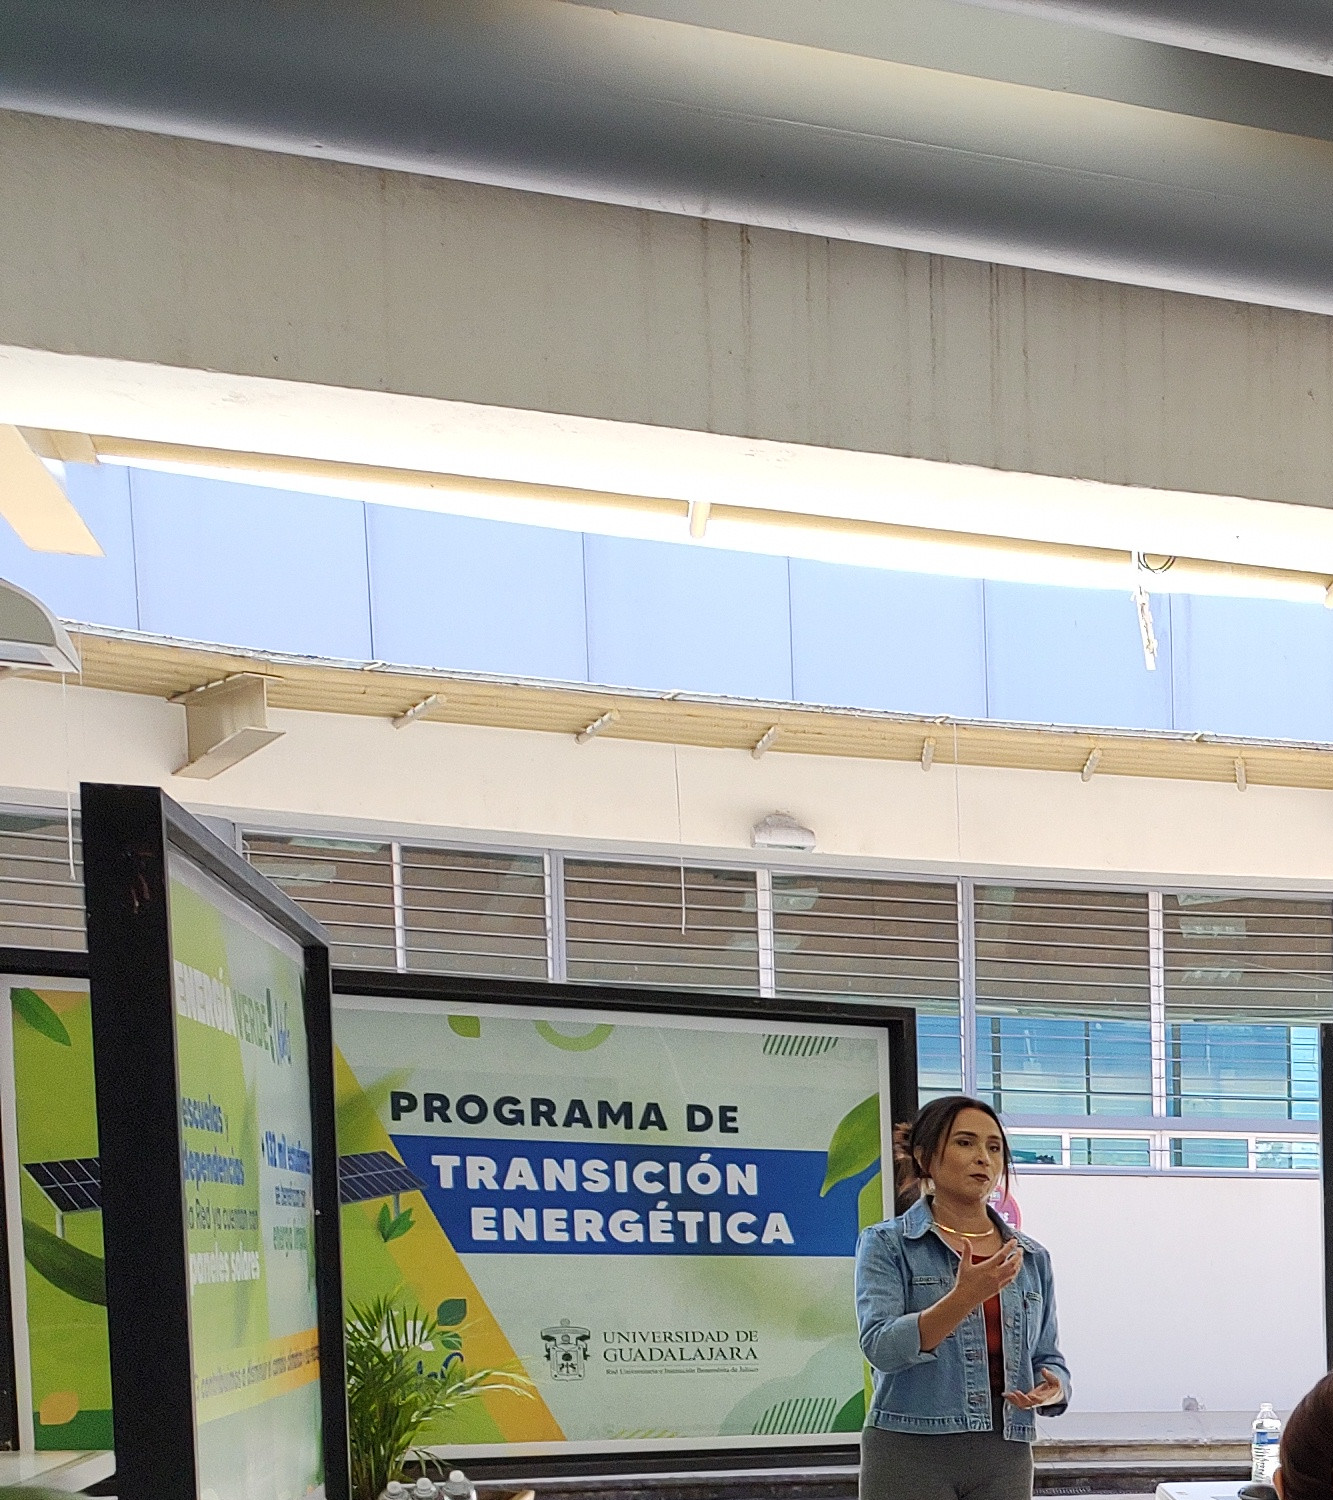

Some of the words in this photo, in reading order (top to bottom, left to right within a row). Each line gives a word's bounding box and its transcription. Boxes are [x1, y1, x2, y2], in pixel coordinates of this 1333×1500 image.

[182, 1094, 223, 1134] escuelas
[390, 1091, 668, 1131] PROGRAMA
[686, 1104, 740, 1133] DE
[431, 1153, 758, 1195] TRANSICIÓN
[470, 1201, 794, 1244] ENERGÉTICA
[189, 1240, 230, 1296] paneles
[231, 1239, 260, 1281] solares
[602, 1331, 729, 1344] UNIVERSIDAD
[736, 1330, 758, 1343] DE
[602, 1347, 758, 1363] GUADALAJARA
